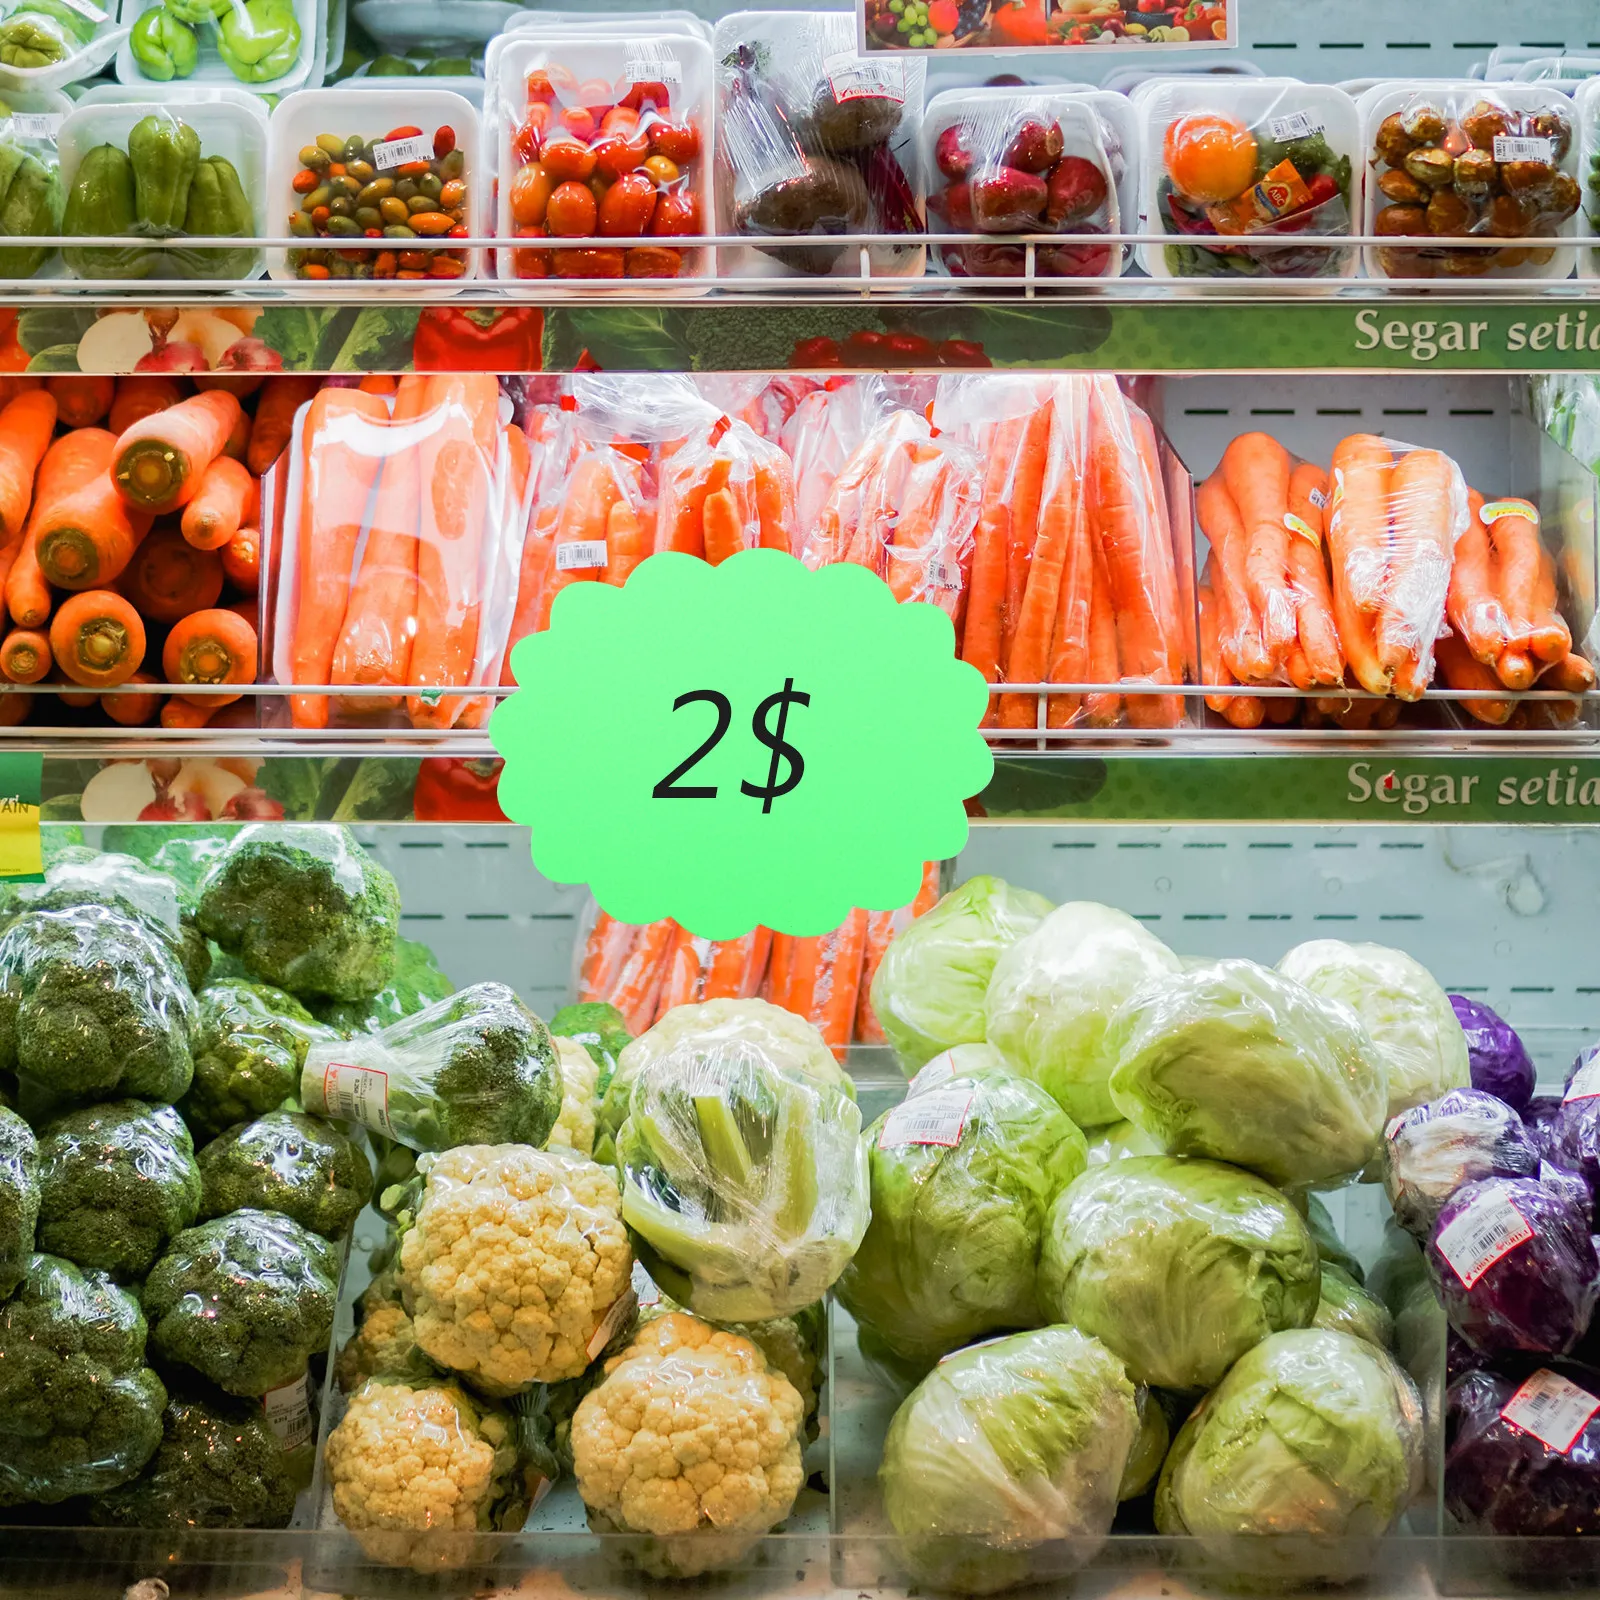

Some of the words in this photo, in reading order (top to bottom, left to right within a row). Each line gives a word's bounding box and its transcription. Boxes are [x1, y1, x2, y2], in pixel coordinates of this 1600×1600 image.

[1269, 188, 1285, 206] ABC
[1354, 308, 1489, 362] Segar
[1346, 761, 1480, 815] Segar
